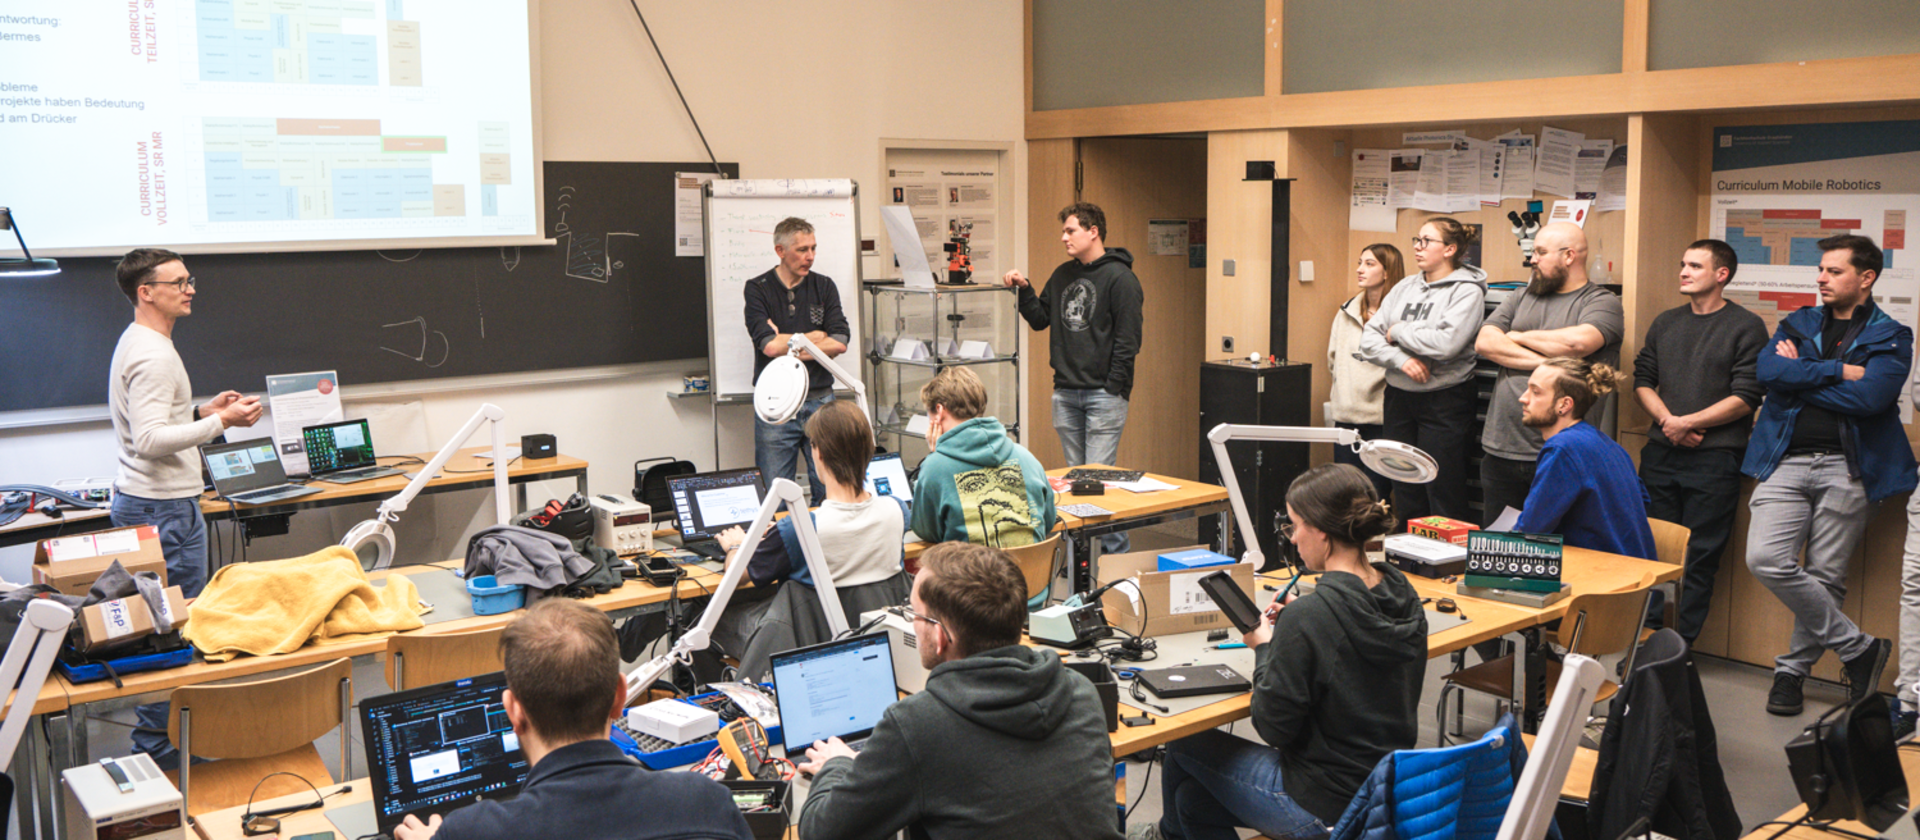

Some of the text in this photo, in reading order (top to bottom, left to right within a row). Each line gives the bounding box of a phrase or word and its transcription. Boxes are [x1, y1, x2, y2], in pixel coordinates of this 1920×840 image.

[144, 0, 155, 9] S
[0, 82, 38, 92] bleme
[45, 97, 81, 107] haben
[84, 97, 145, 111] Bedeutung
[8, 115, 28, 123] am
[31, 112, 77, 124] Drücker
[152, 131, 163, 149] MR
[153, 152, 164, 167] SR
[137, 141, 151, 216] CURRICULUM
[1717, 179, 1881, 191] Curriculum Mobile Robotics
